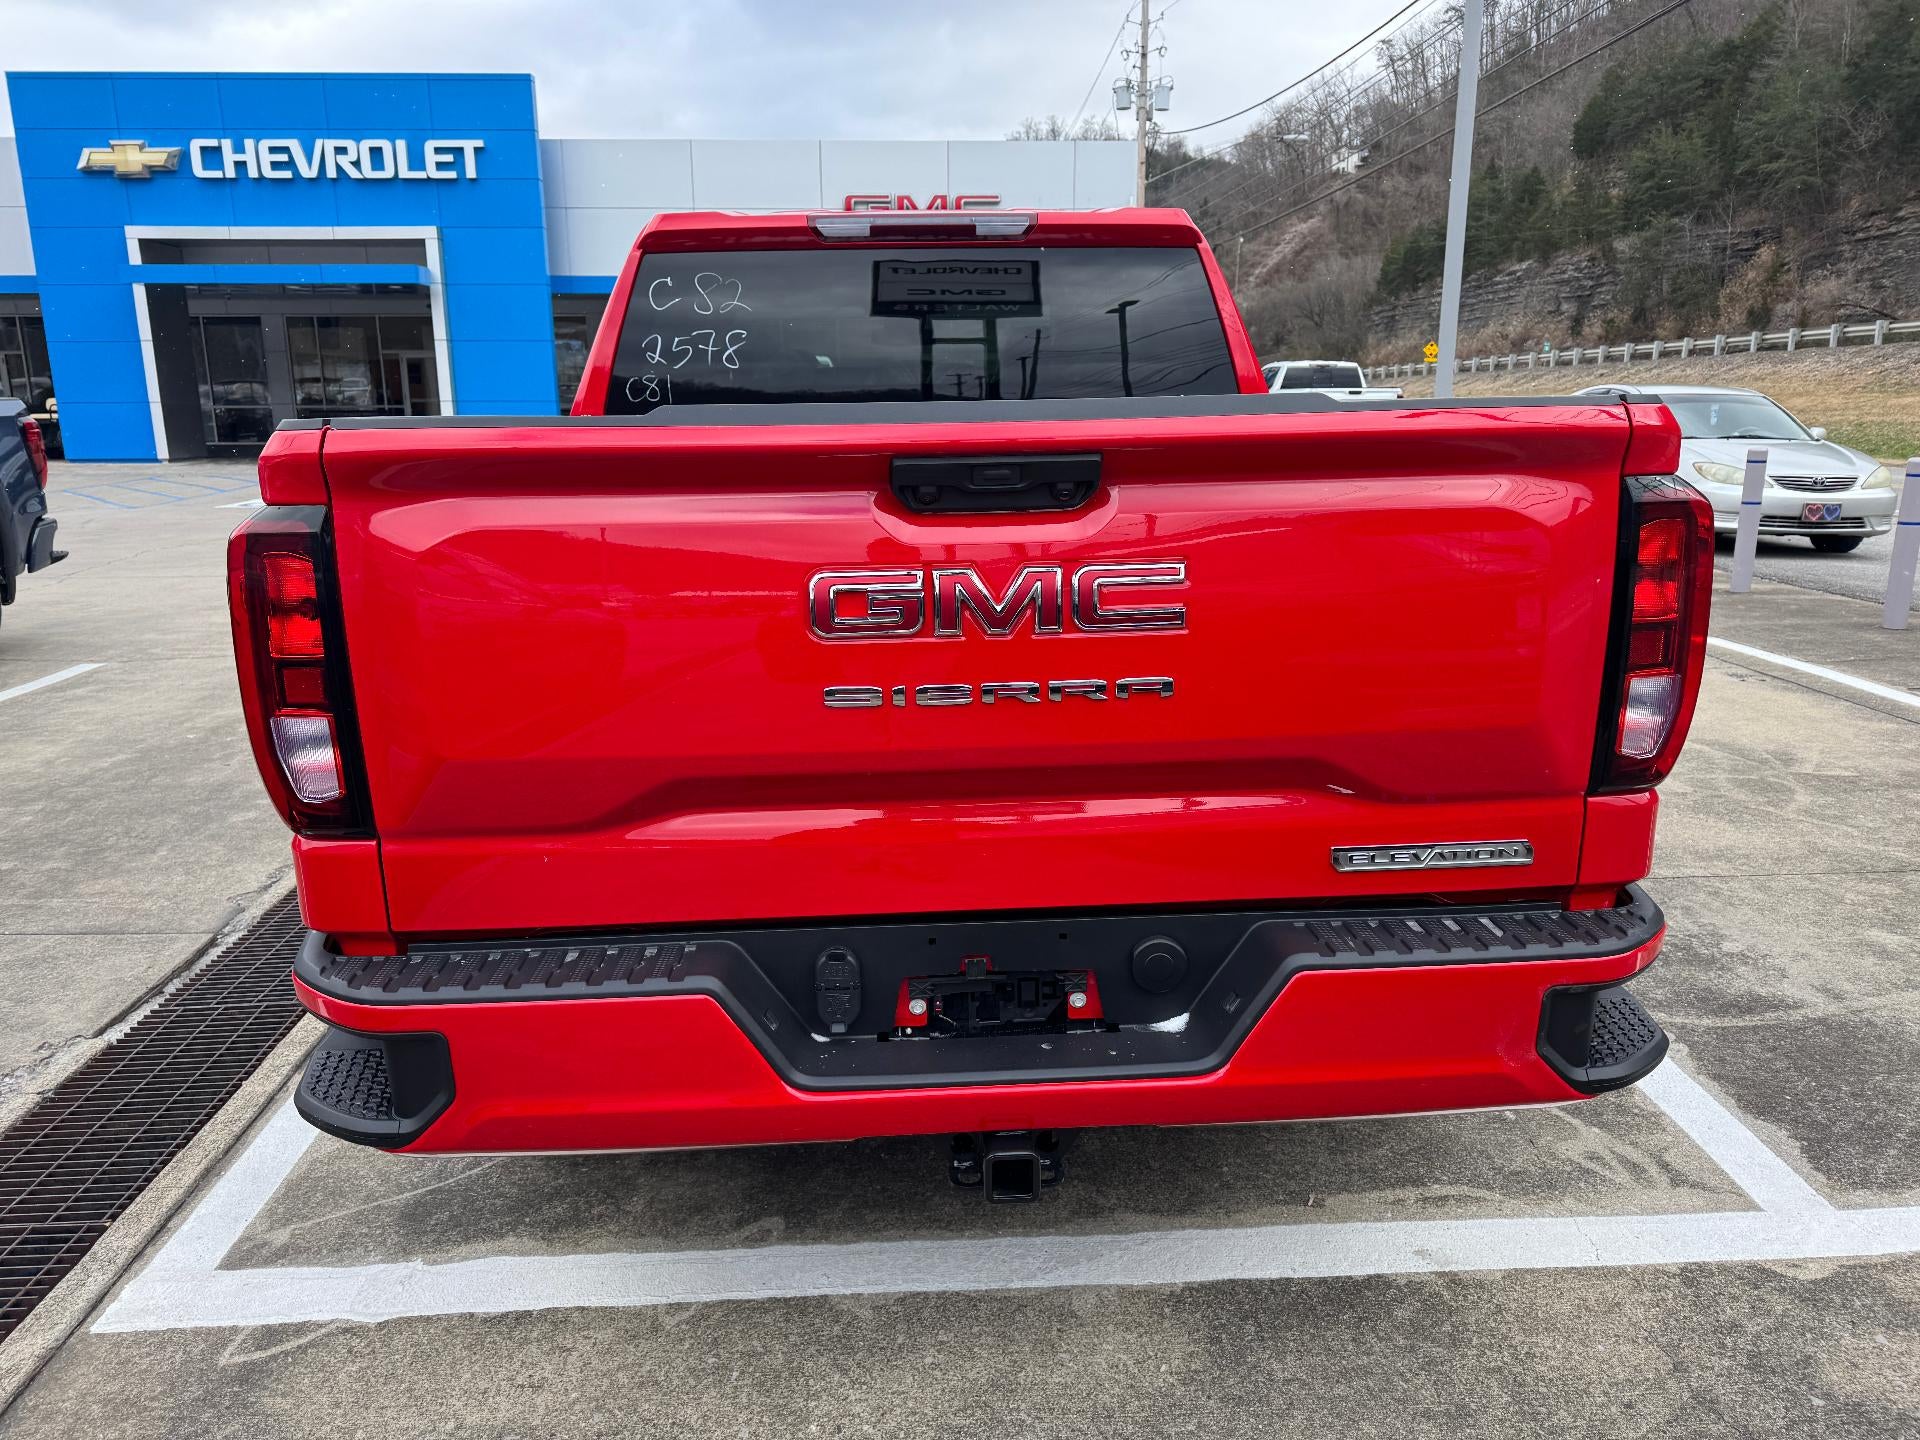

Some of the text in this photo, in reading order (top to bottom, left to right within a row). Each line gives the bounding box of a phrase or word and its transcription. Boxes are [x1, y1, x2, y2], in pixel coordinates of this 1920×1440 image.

[189, 138, 486, 181] CHEVROLET
[641, 329, 747, 369] 2578
[625, 374, 672, 404] C81
[808, 560, 1188, 641] GMC
[823, 676, 1175, 708] SIERRA
[1347, 845, 1520, 866] ELEVATION
